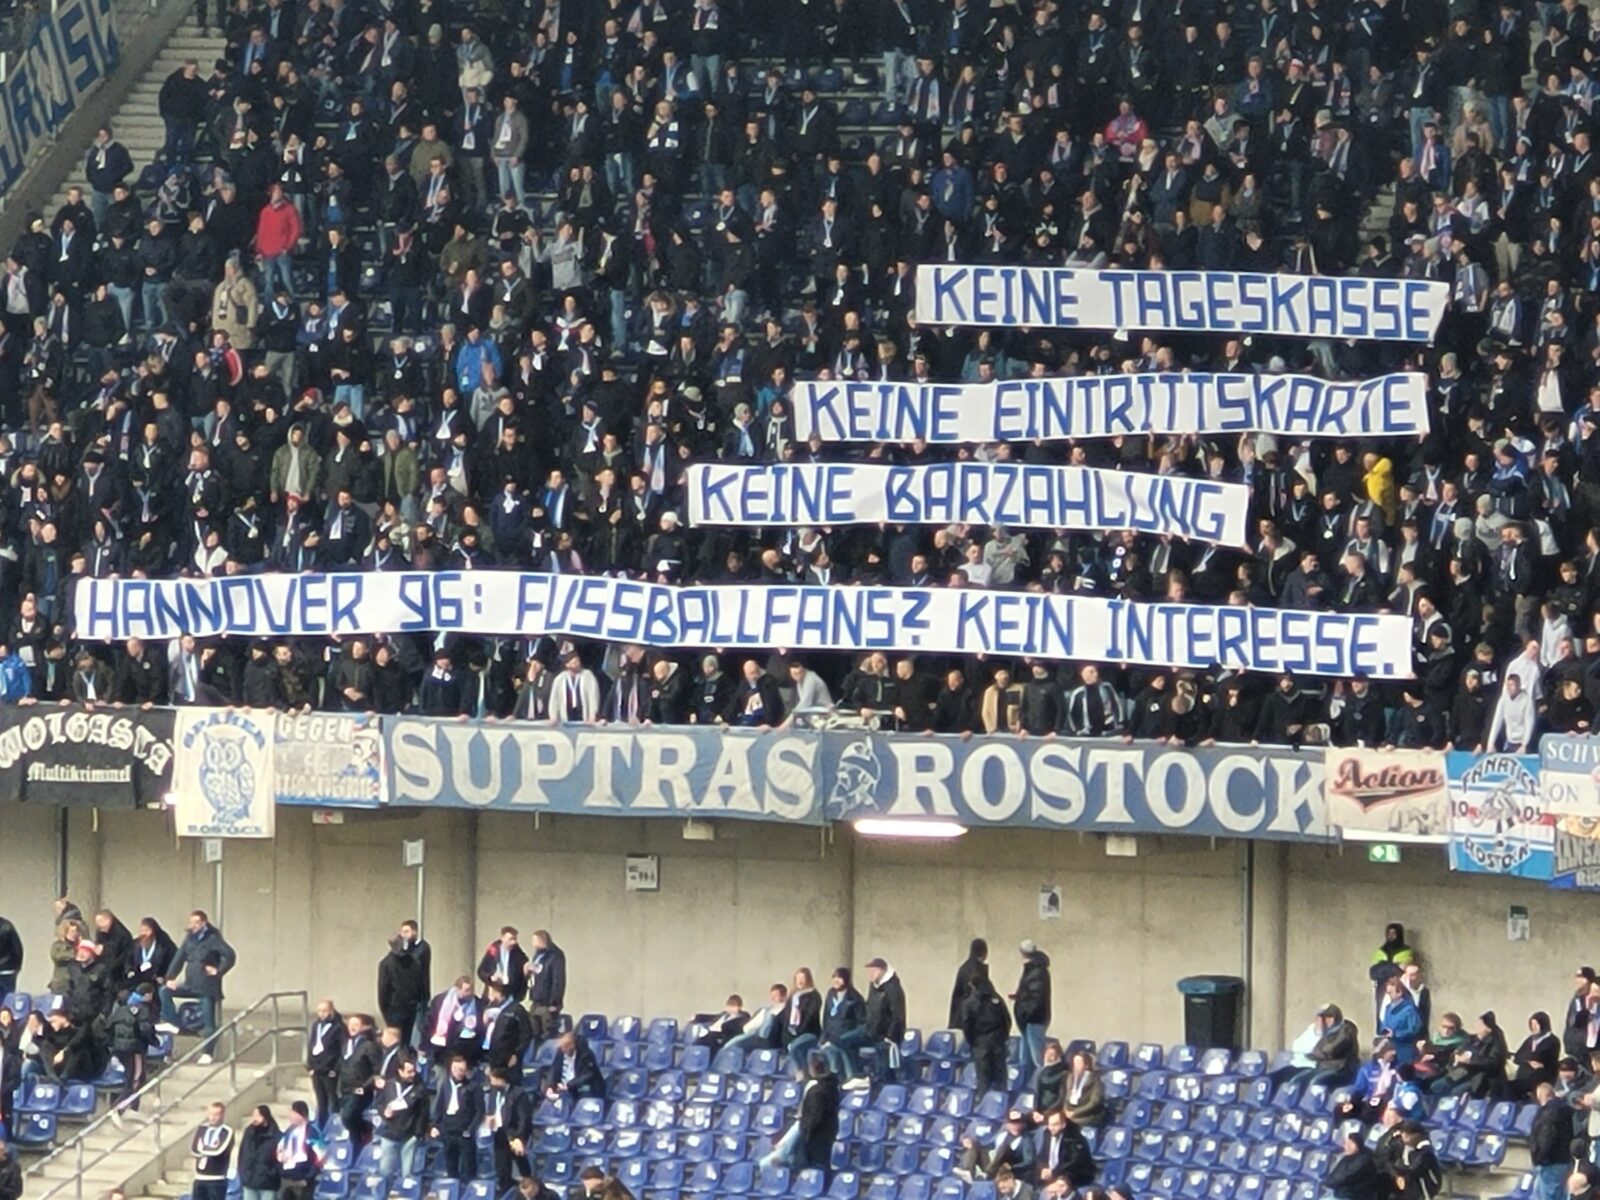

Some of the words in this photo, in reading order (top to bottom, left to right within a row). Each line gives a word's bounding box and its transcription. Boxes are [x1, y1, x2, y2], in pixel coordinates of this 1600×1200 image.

[933, 267, 1080, 327] KEINE
[1098, 270, 1432, 340] TAGESKASSE
[807, 382, 964, 442] KEINE
[992, 374, 1418, 436] EINTRITTSKARTE
[700, 465, 856, 523] KEINE
[884, 463, 1226, 542] BARZAHLUNG
[88, 574, 363, 638] HANNOVER
[399, 574, 485, 629] 96:
[516, 574, 932, 650] FUSSBALLFANS?
[957, 592, 1075, 657] KEIN
[1105, 600, 1396, 675] INTERESSE.
[388, 722, 820, 820] SUPTRAS
[890, 740, 1324, 836] ROSTOCK
[1333, 757, 1440, 790] Action
